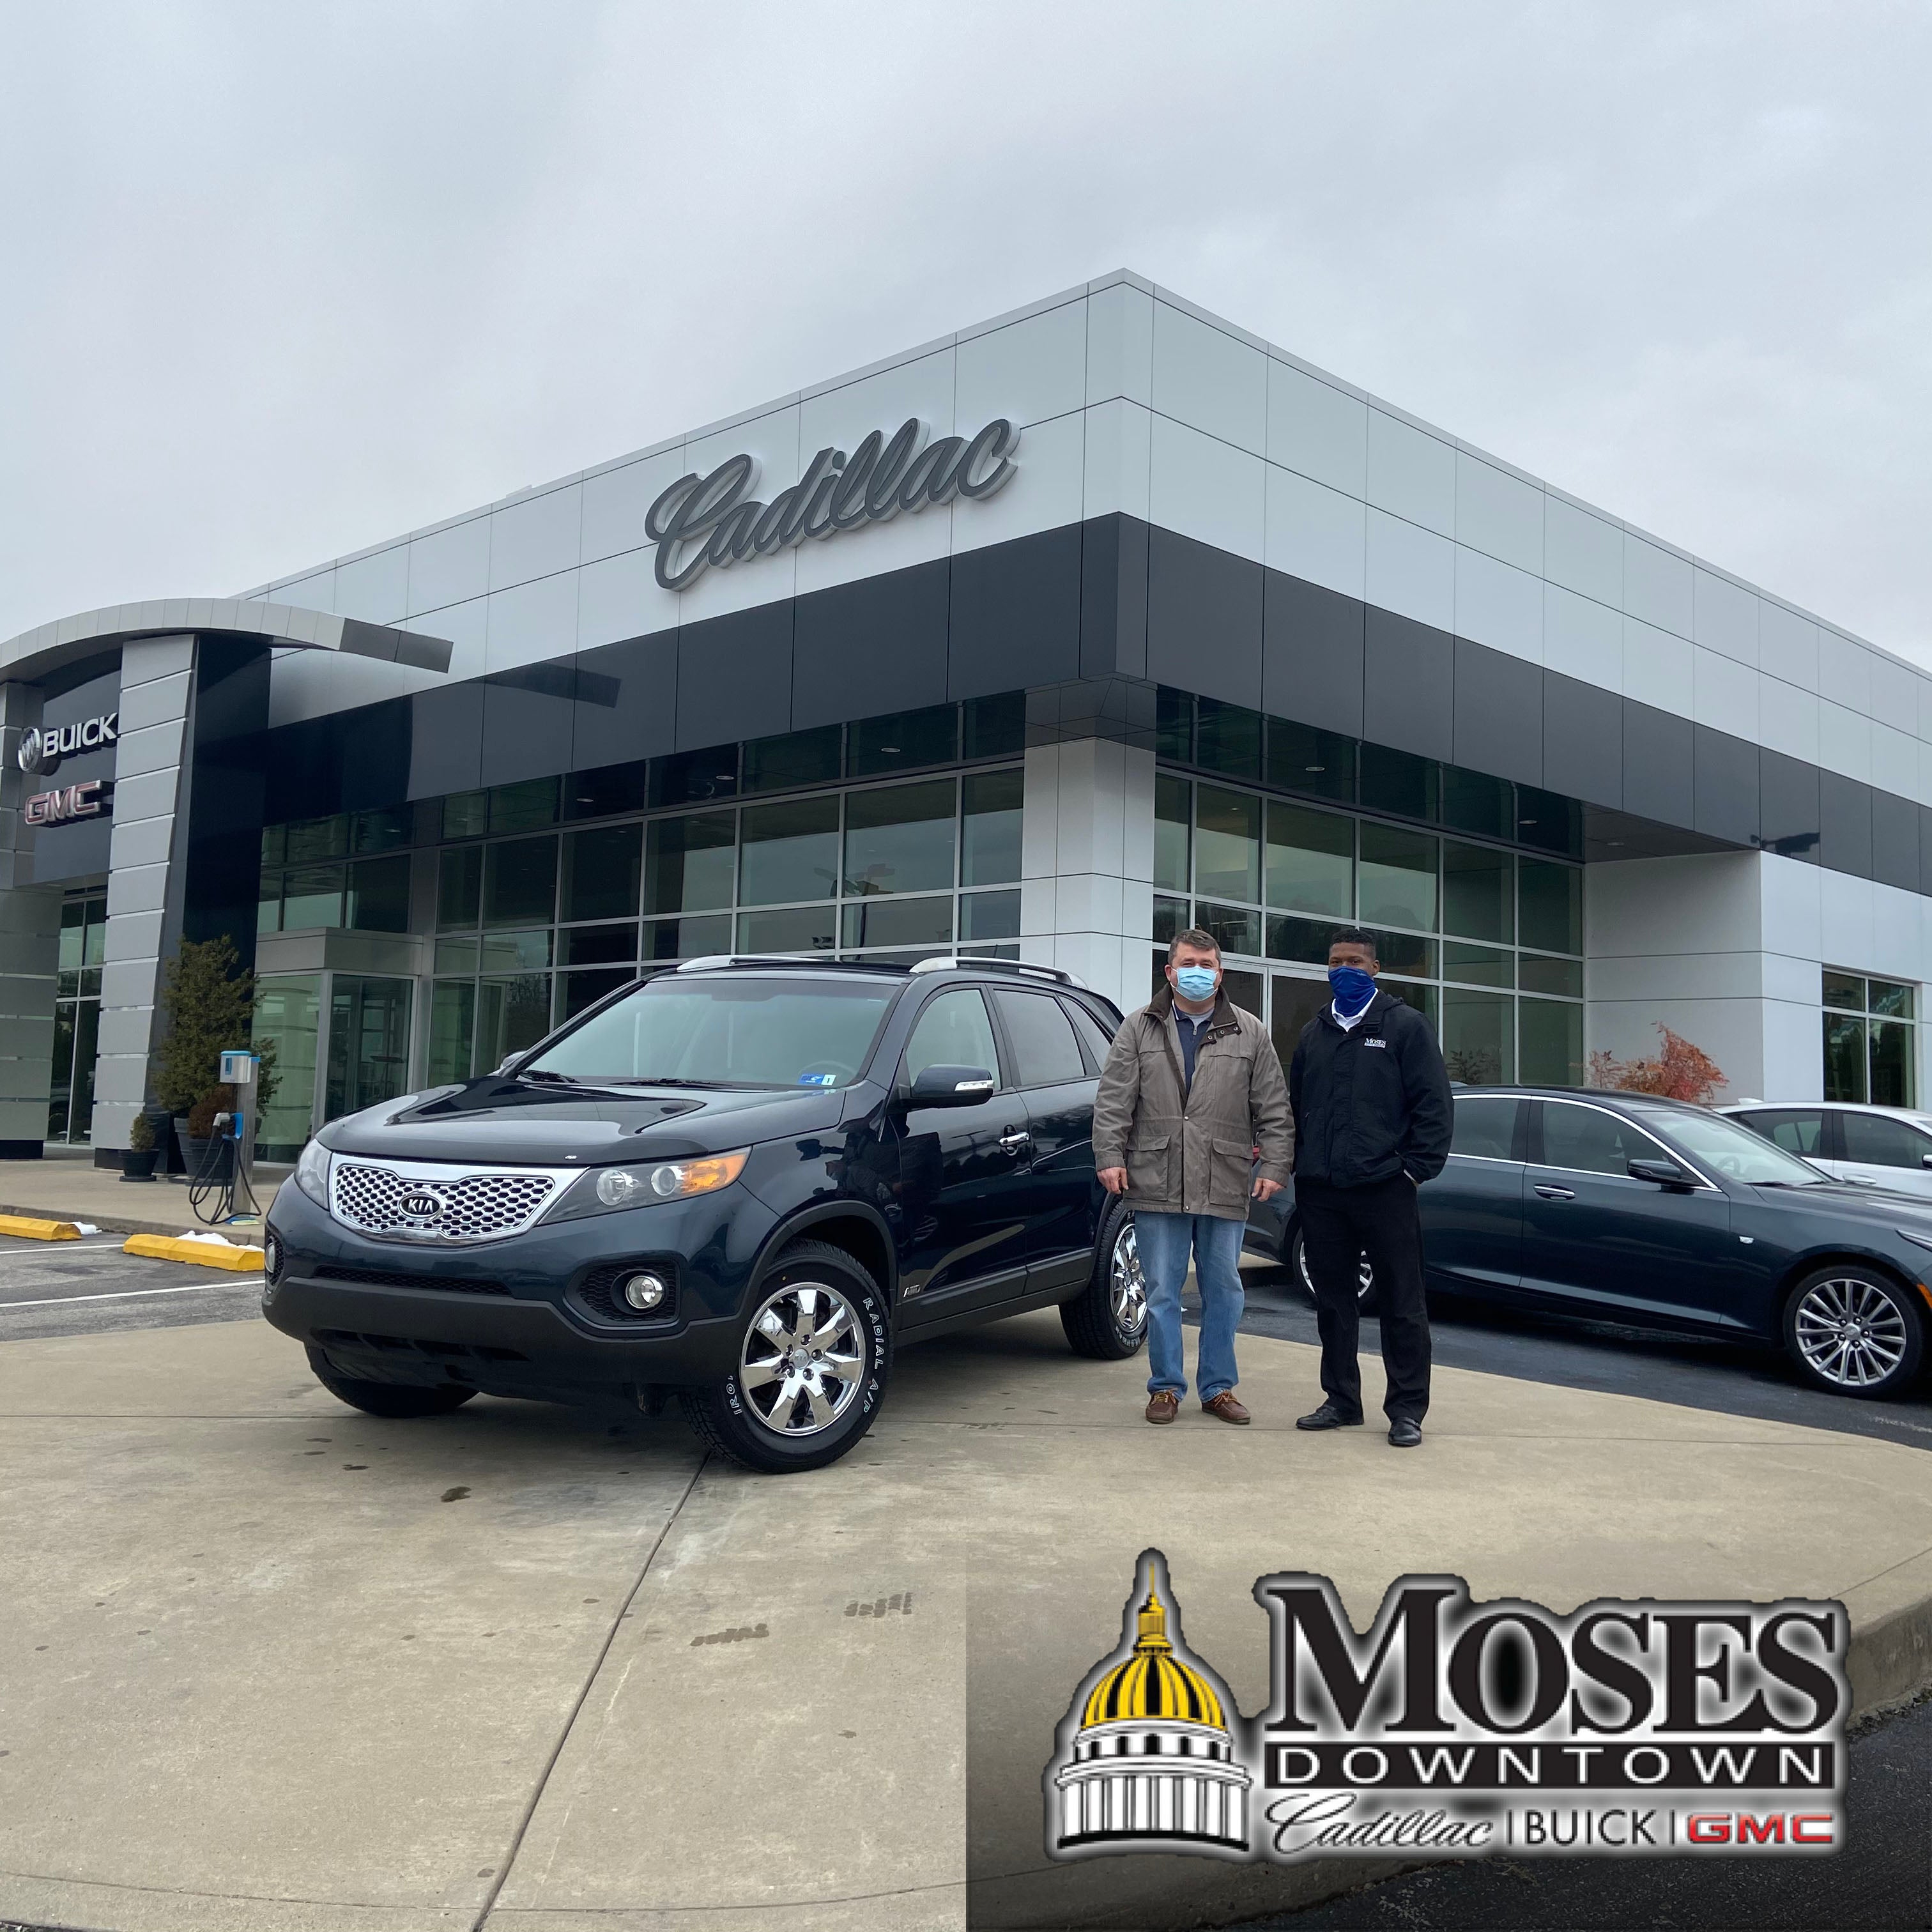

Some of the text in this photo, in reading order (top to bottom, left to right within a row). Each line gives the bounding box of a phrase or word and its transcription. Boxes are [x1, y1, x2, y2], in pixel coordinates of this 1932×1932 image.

[645, 417, 1020, 591] Cadillac
[42, 712, 118, 757] BUICK
[25, 779, 101, 825] GMC
[408, 1199, 433, 1213] KIA
[862, 1298, 884, 1413] RADIAL A/P
